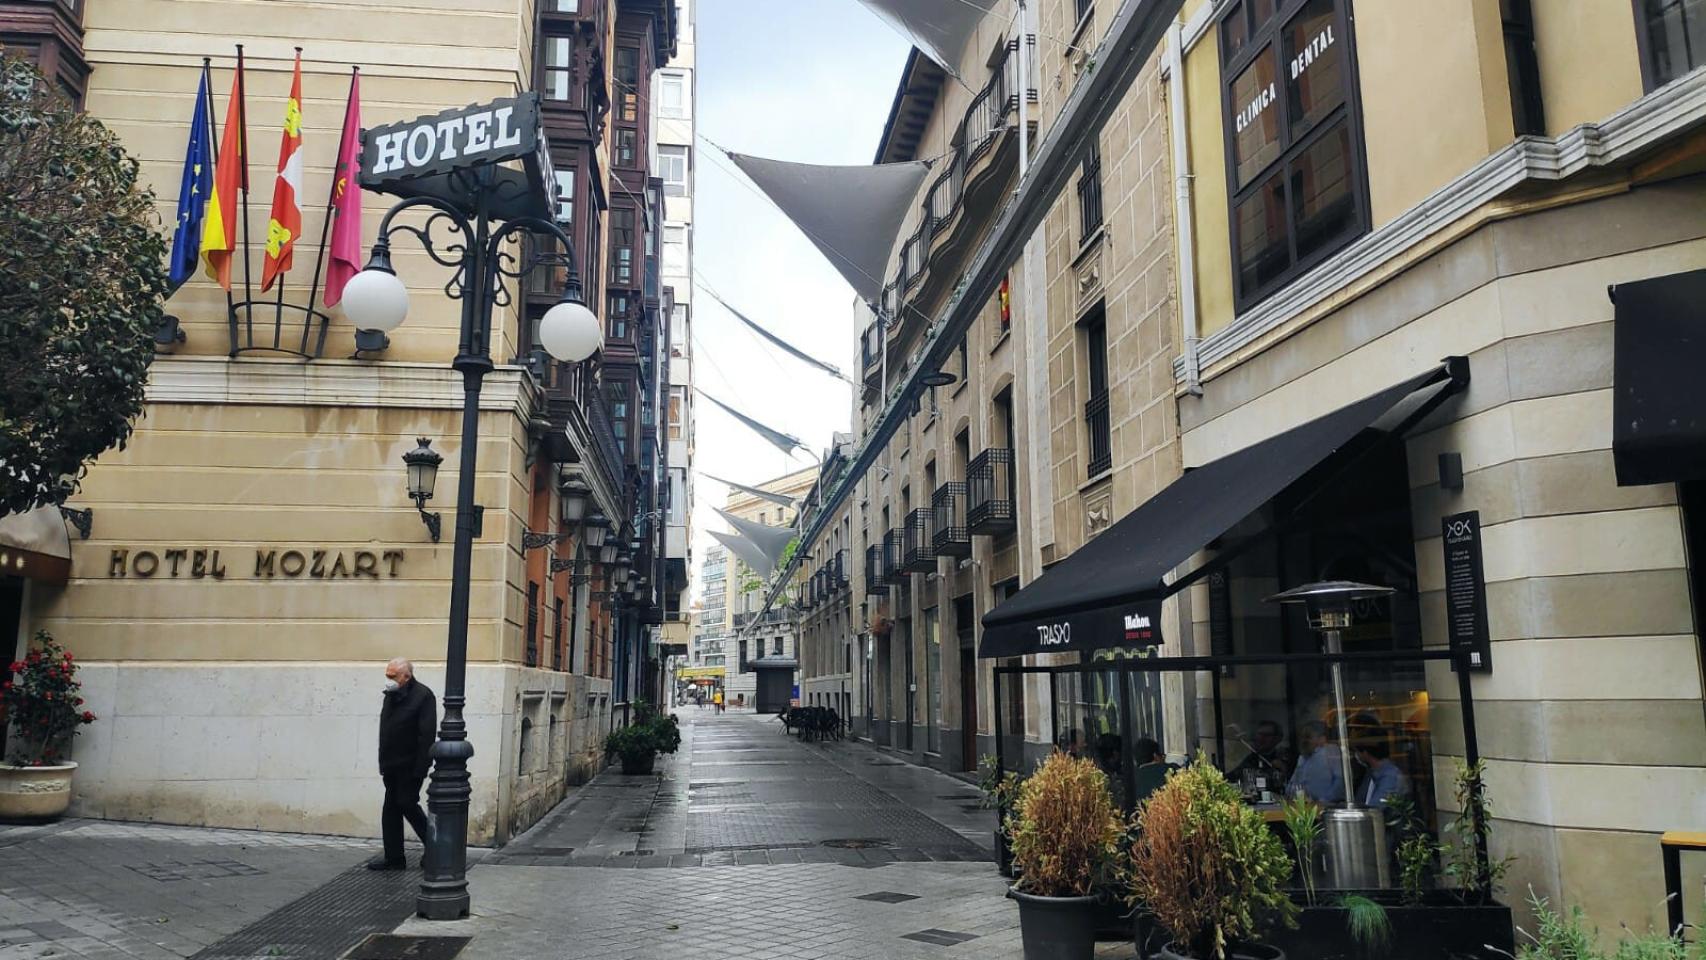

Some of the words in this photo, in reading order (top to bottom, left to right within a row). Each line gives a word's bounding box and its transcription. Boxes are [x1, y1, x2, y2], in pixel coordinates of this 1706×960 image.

[1235, 82, 1276, 133] CLINICA
[1290, 24, 1335, 80] DENTAL
[372, 106, 521, 175] HOTEL
[109, 548, 226, 579] HOTEL
[254, 549, 404, 579] MOZART
